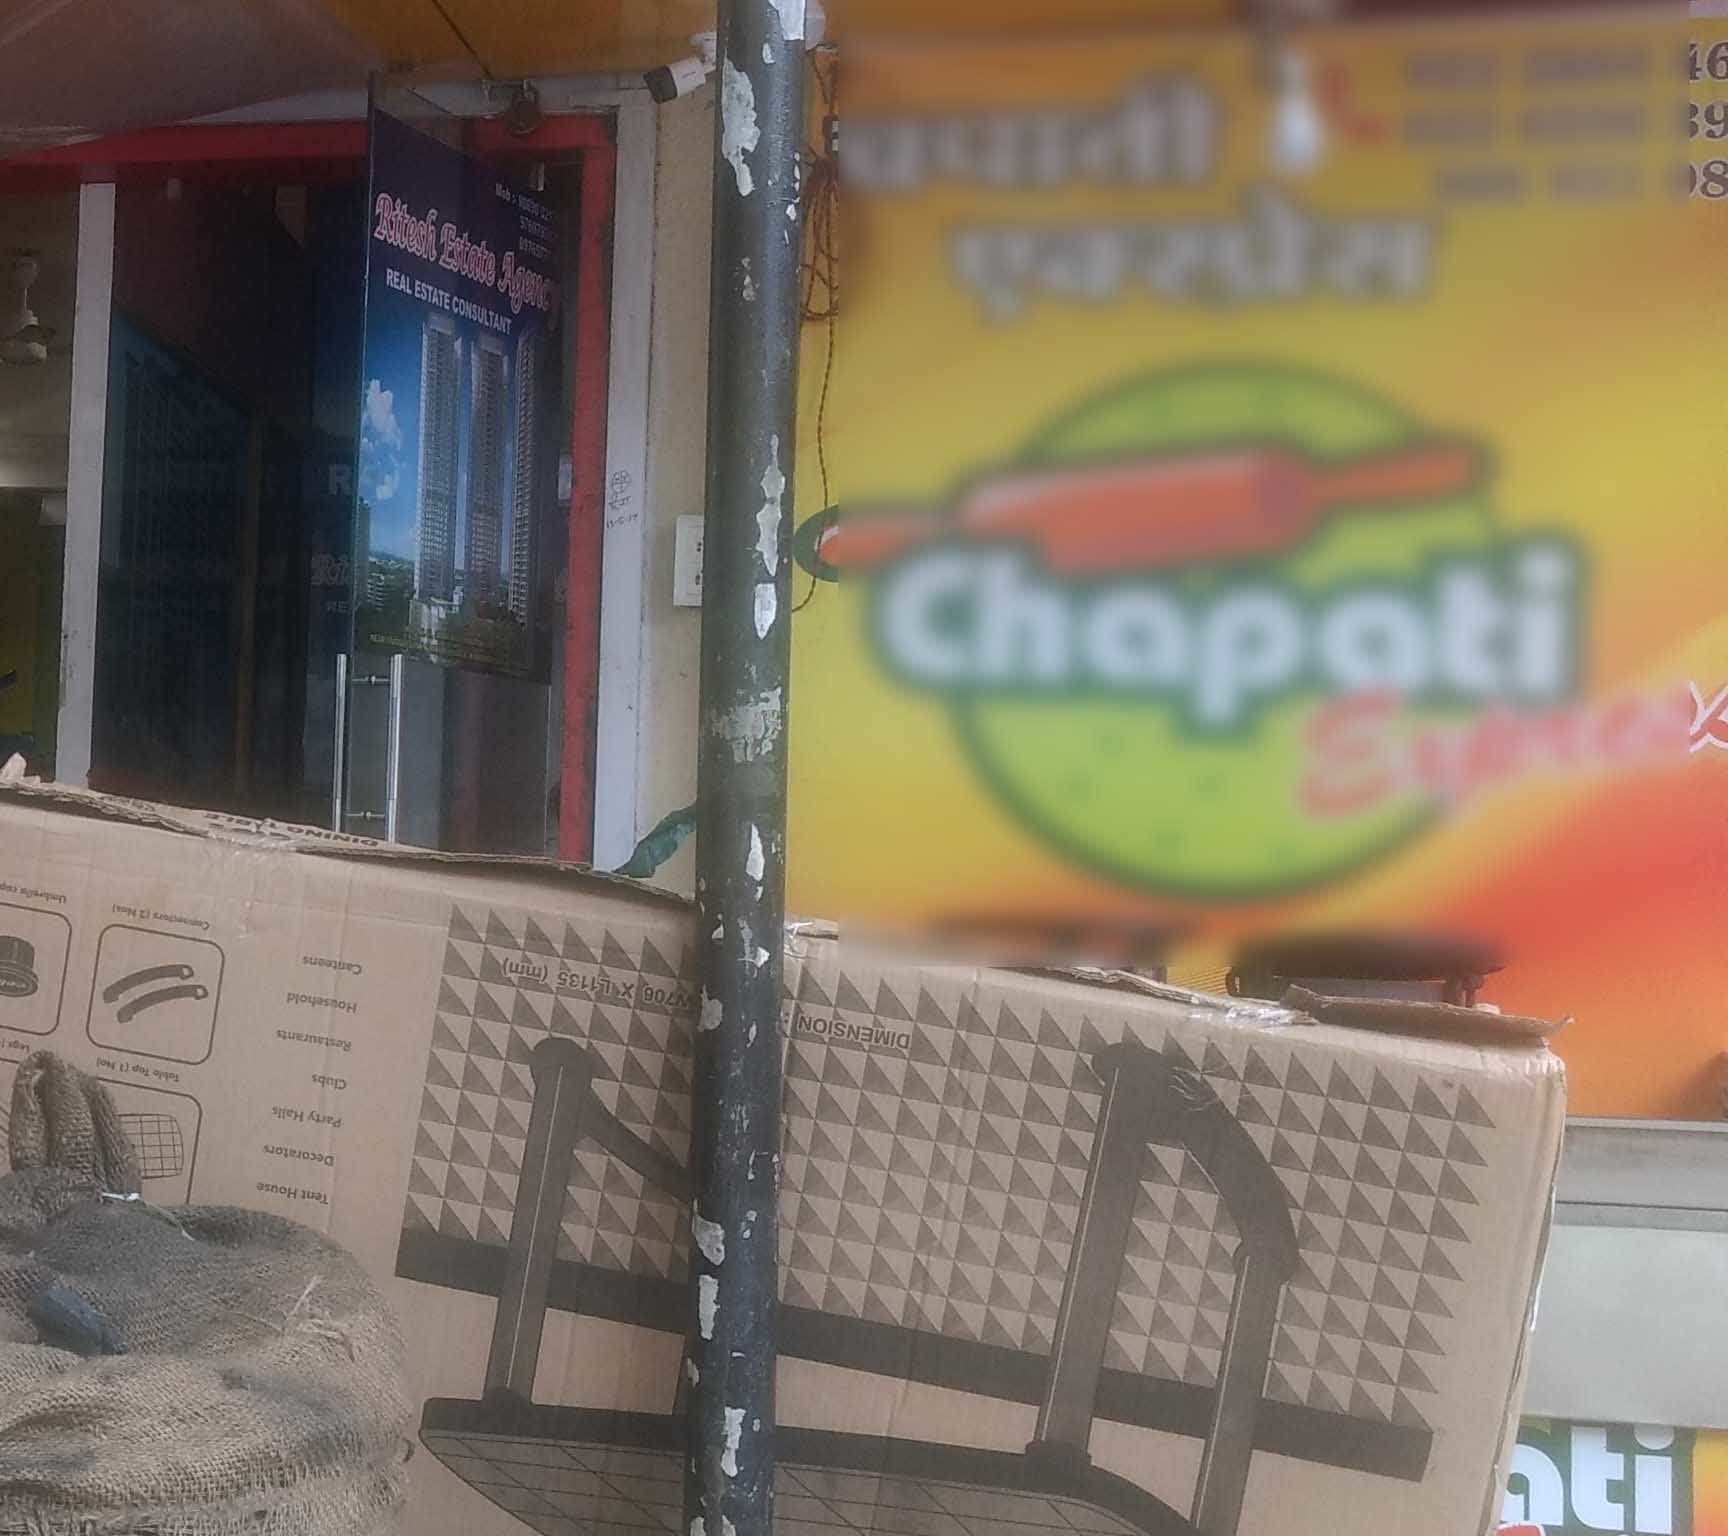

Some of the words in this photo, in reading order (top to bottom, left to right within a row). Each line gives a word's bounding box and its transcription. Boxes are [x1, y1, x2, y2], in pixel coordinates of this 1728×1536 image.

[374, 192, 438, 262] Ritesh
[439, 222, 496, 287] Estate
[386, 268, 412, 296] REAL
[414, 279, 450, 311] ESTATE
[452, 296, 512, 336] CONSULTANT
[302, 954, 362, 976] Canteens
[500, 957, 549, 984] (mm)
[556, 968, 611, 995] L1135
[286, 991, 358, 1014] Household
[275, 1028, 352, 1052] Restaurants
[795, 1012, 912, 1050] DIMENSION
[152, 1066, 179, 1084] Table
[311, 1073, 347, 1090] Clubs
[271, 1105, 303, 1123] Halls
[305, 1105, 342, 1128] Party
[262, 1144, 335, 1167] Decorators
[256, 1180, 298, 1200] House
[302, 1185, 329, 1205] Tent
